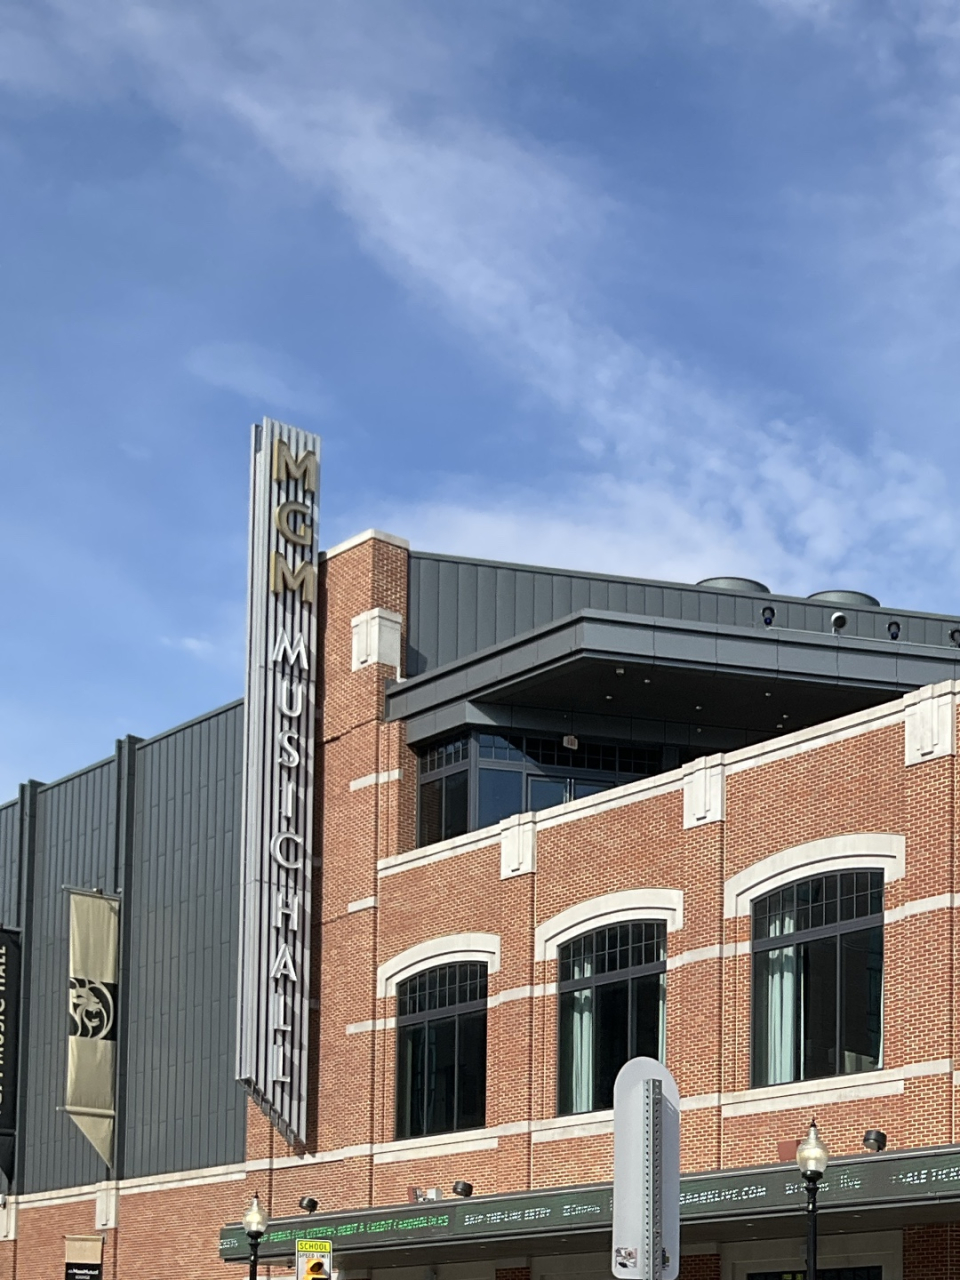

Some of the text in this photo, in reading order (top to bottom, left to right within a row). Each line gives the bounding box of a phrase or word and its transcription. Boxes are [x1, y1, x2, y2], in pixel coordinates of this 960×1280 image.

[270, 439, 316, 603] MGM
[270, 628, 309, 1083] MUSIC HALL
[299, 1243, 329, 1251] SCHOOL
